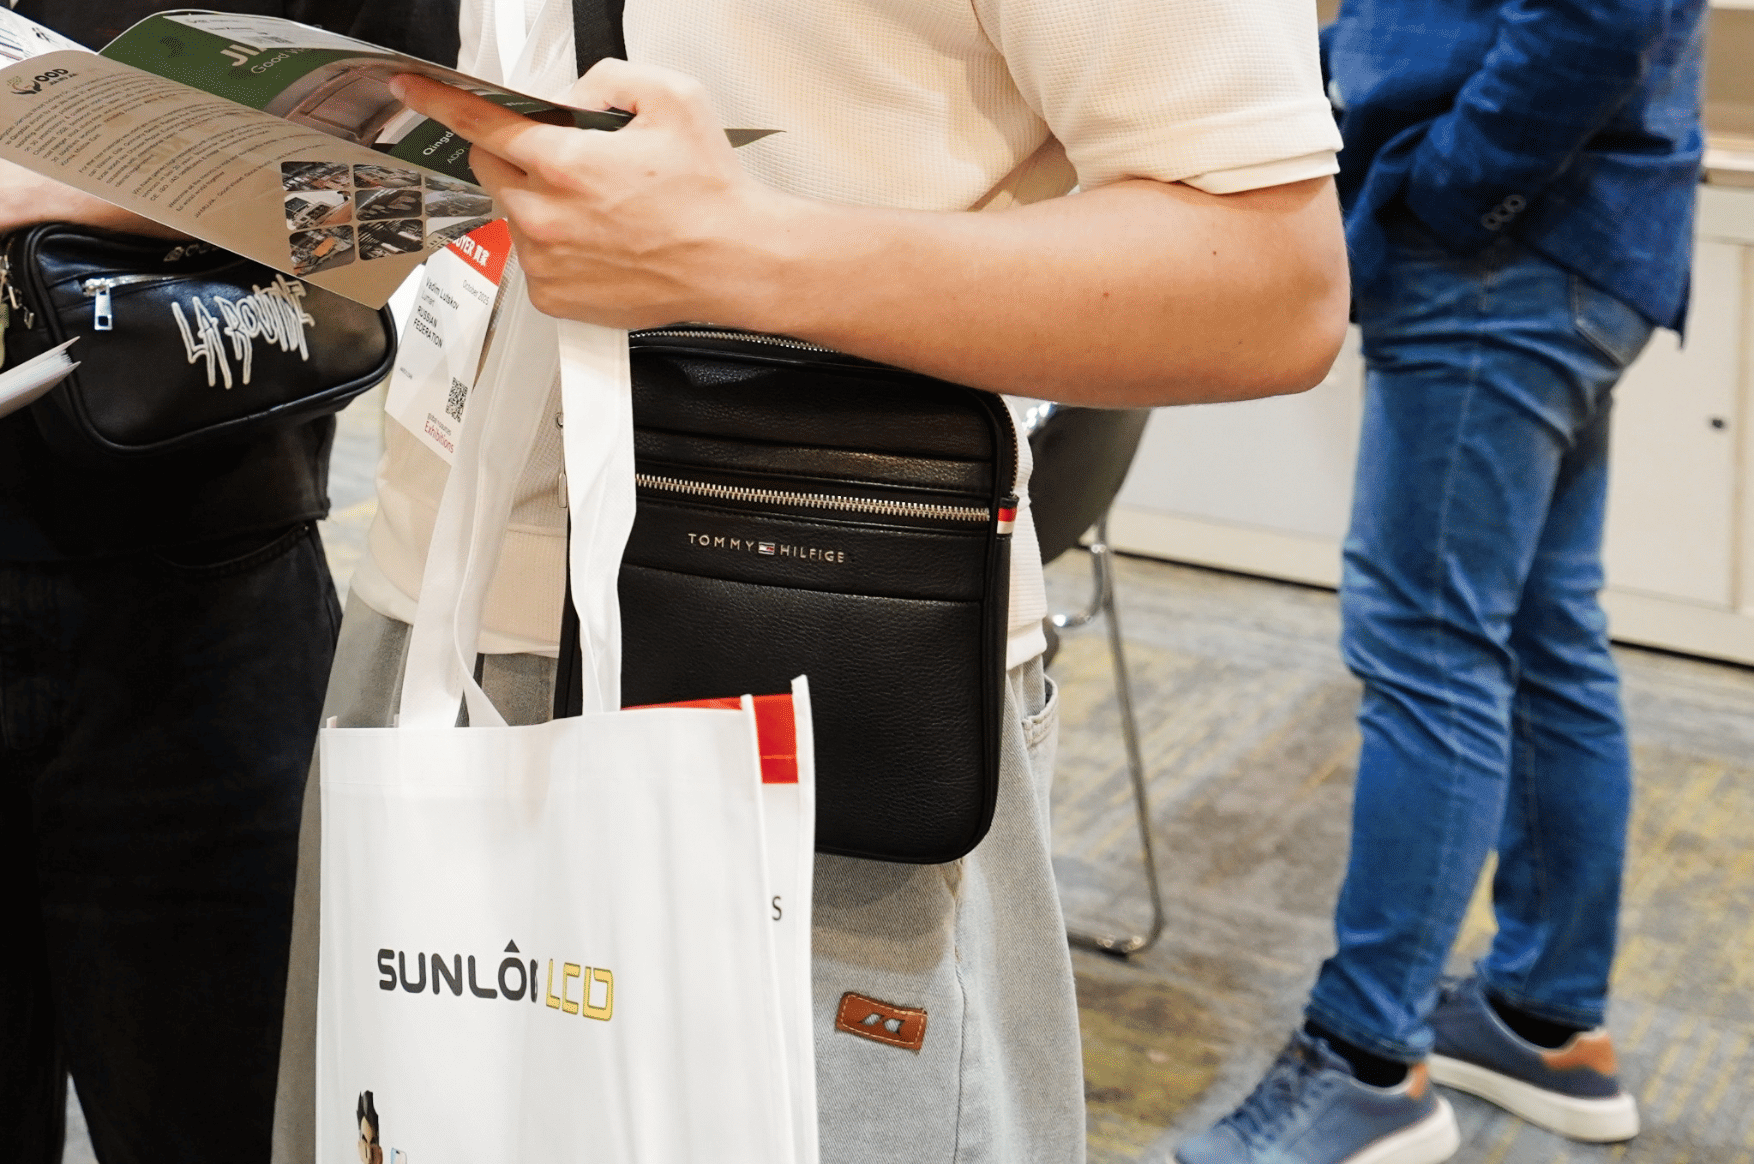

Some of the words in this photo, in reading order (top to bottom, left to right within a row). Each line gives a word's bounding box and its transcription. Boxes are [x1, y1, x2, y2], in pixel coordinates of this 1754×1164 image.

[250, 51, 291, 74] Good
[425, 276, 441, 296] Vadim
[416, 305, 438, 328] RUSSIAN
[171, 296, 233, 390] LA
[413, 317, 444, 349] FEDERATION
[424, 420, 454, 454] Exhibitions
[687, 533, 755, 552] TOMMY
[780, 544, 845, 563] HILFIGE
[771, 895, 783, 922] S
